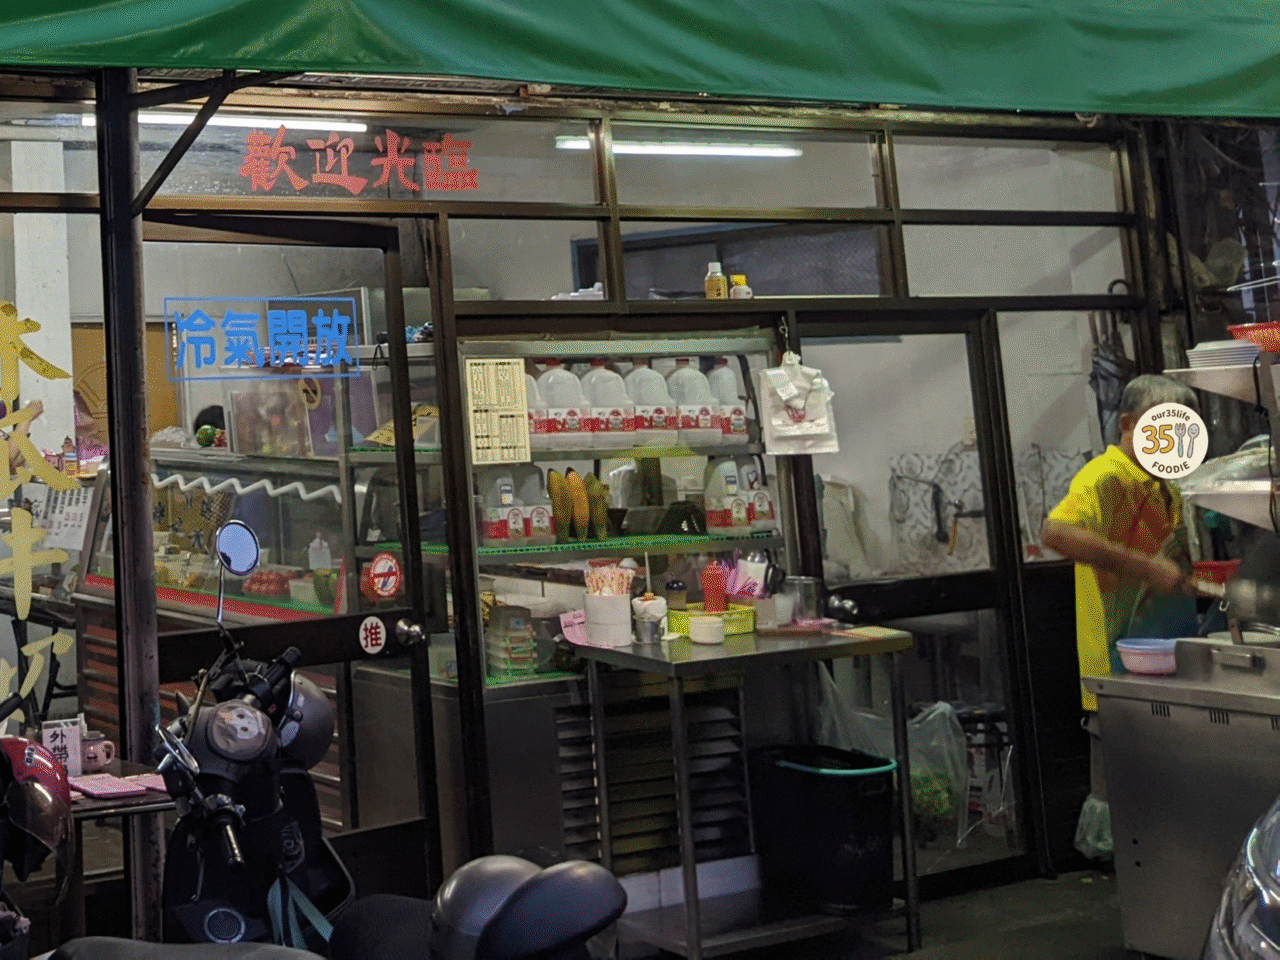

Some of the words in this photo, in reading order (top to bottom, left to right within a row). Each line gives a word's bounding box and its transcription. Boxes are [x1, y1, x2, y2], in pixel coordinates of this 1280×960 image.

[238, 124, 481, 195] 歡迎光臨
[173, 308, 352, 369] 冷氣開放
[363, 622, 383, 648] 推
